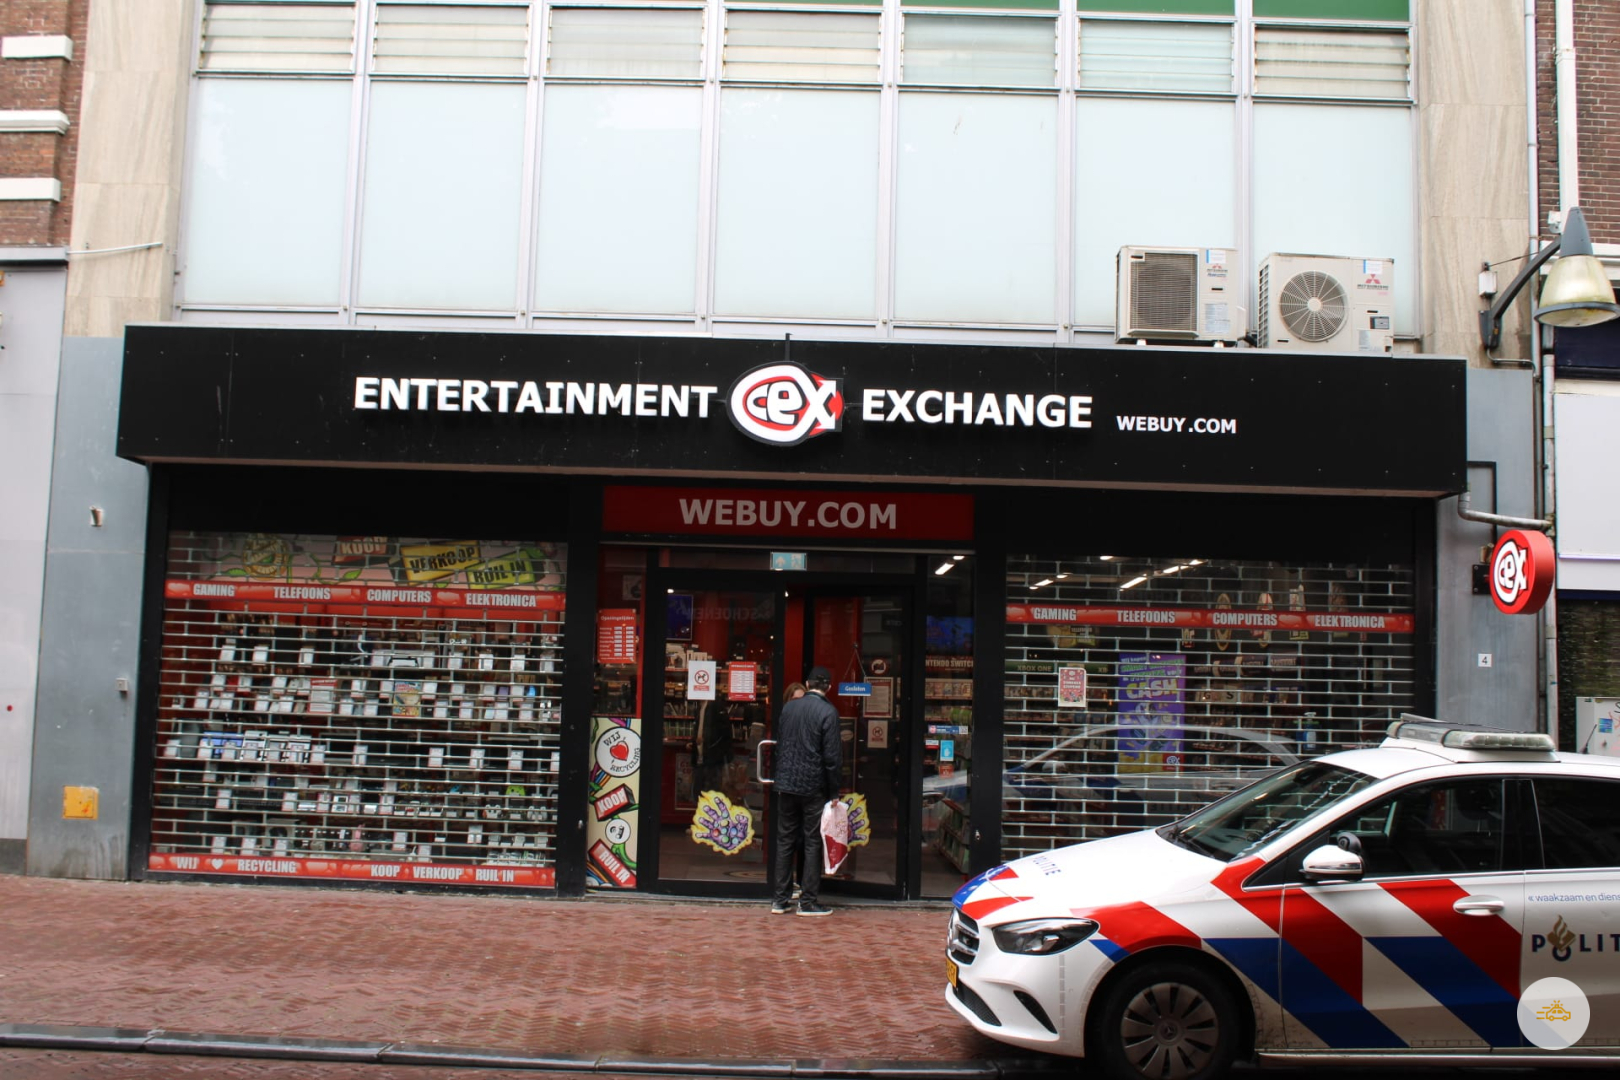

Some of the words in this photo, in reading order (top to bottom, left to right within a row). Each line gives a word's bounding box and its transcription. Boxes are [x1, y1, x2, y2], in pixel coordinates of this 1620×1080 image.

[354, 376, 717, 418] ENTERTAINMENT
[863, 389, 1093, 428] EXCHANGE
[1116, 415, 1237, 435] WEBUY.COM
[679, 498, 897, 530] WEBUY.COM
[409, 546, 476, 574] VERKOOP
[473, 565, 509, 583] RUIL
[510, 560, 527, 577] IN
[193, 584, 235, 597] GAMING
[273, 586, 331, 600] TELEFOONS
[367, 589, 432, 603] COMPUTERS
[466, 593, 537, 608] ELEKTRONICA
[1033, 607, 1077, 621] GAMING
[1116, 610, 1175, 624] TELEFOONS
[1213, 612, 1278, 626] COMPUTERS
[1315, 615, 1385, 628] ELEKTRONICA
[1126, 679, 1178, 699] CASH
[603, 731, 621, 746] WIJ
[599, 788, 626, 812] KOOP
[176, 857, 198, 869] WIJ
[237, 859, 297, 873] RECYCLING
[371, 864, 400, 877] KOOP
[413, 866, 463, 880] VERKOOP
[475, 868, 499, 881] RUIL
[502, 869, 514, 882] IN
[598, 849, 621, 874] RUIL
[1535, 893, 1584, 902] waakzaam
[1585, 894, 1598, 902] en
